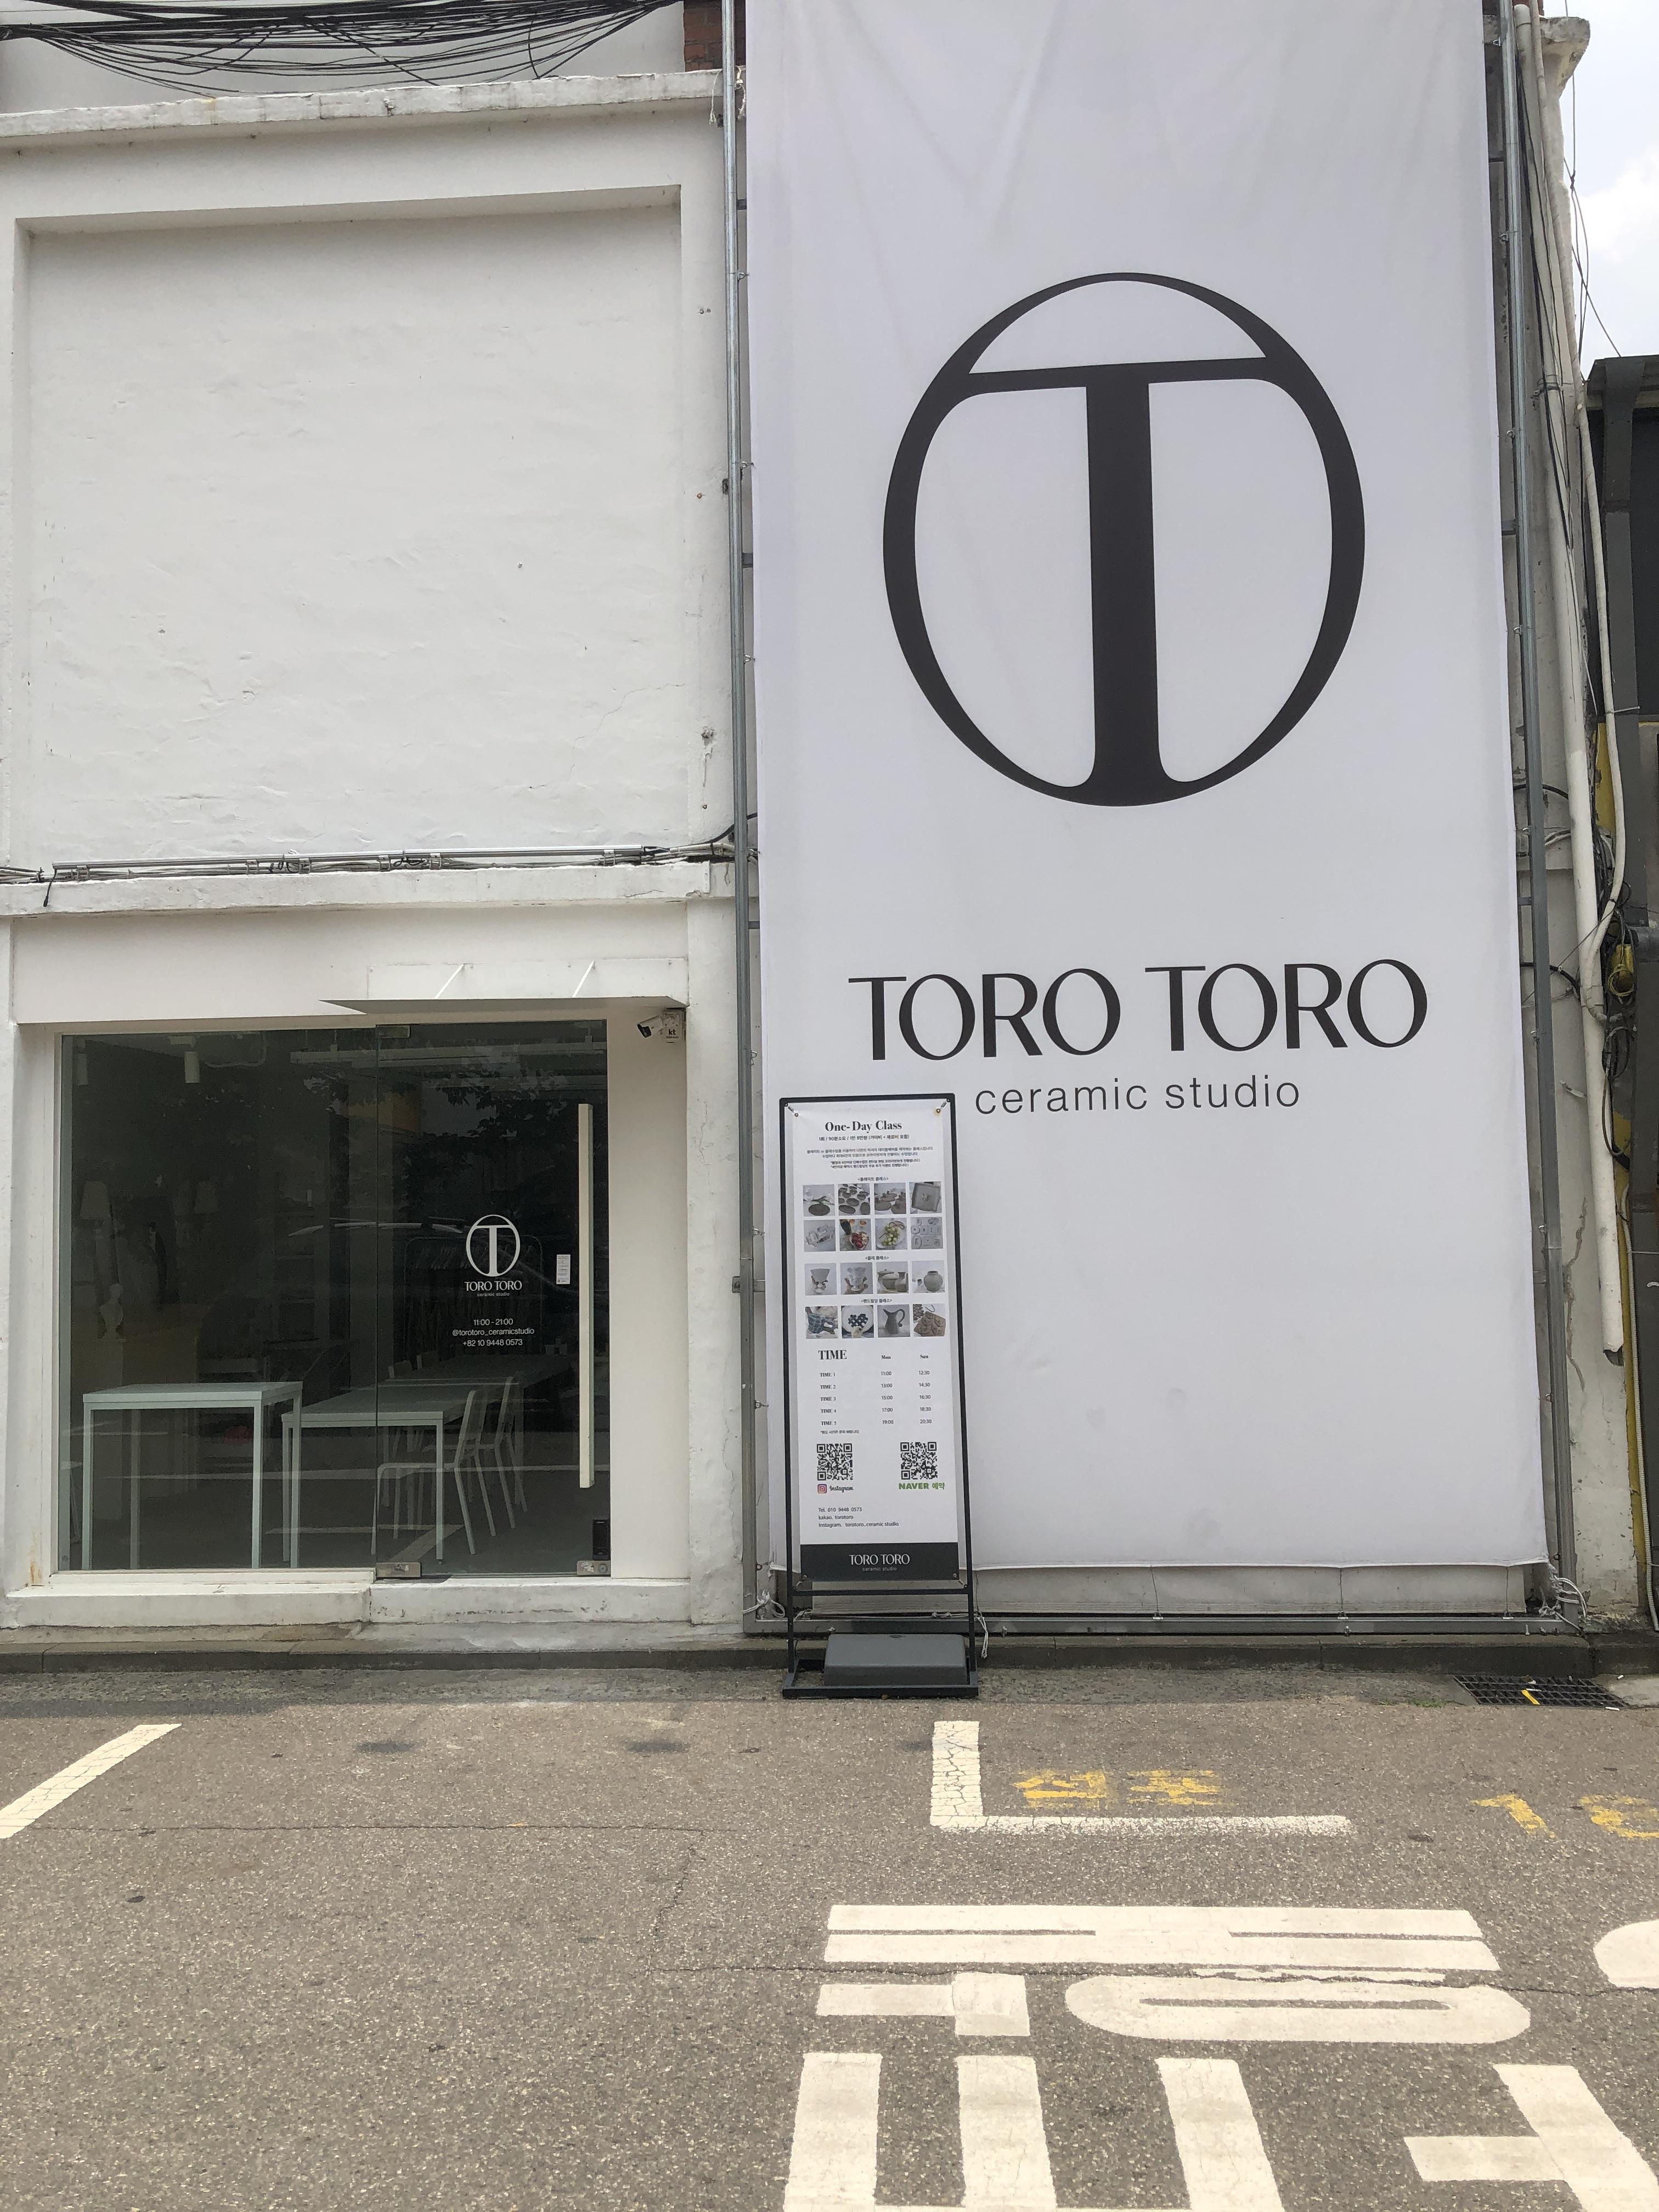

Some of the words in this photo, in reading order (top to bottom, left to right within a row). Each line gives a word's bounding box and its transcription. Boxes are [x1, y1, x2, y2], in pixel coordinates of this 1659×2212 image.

[849, 968, 1120, 1060] TORO
[1145, 960, 1427, 1051] TORO
[976, 1078, 1147, 1114] ceramic
[1166, 1075, 1299, 1109] studio
[876, 1120, 902, 1130] Class
[464, 1281, 492, 1291] TORO
[494, 1280, 522, 1290] TORO
[453, 1328, 534, 1336] @torotoro_ceramicstudio
[818, 1350, 847, 1359] TIME
[849, 1554, 878, 1565] TORO
[881, 1554, 910, 1565] TORO
